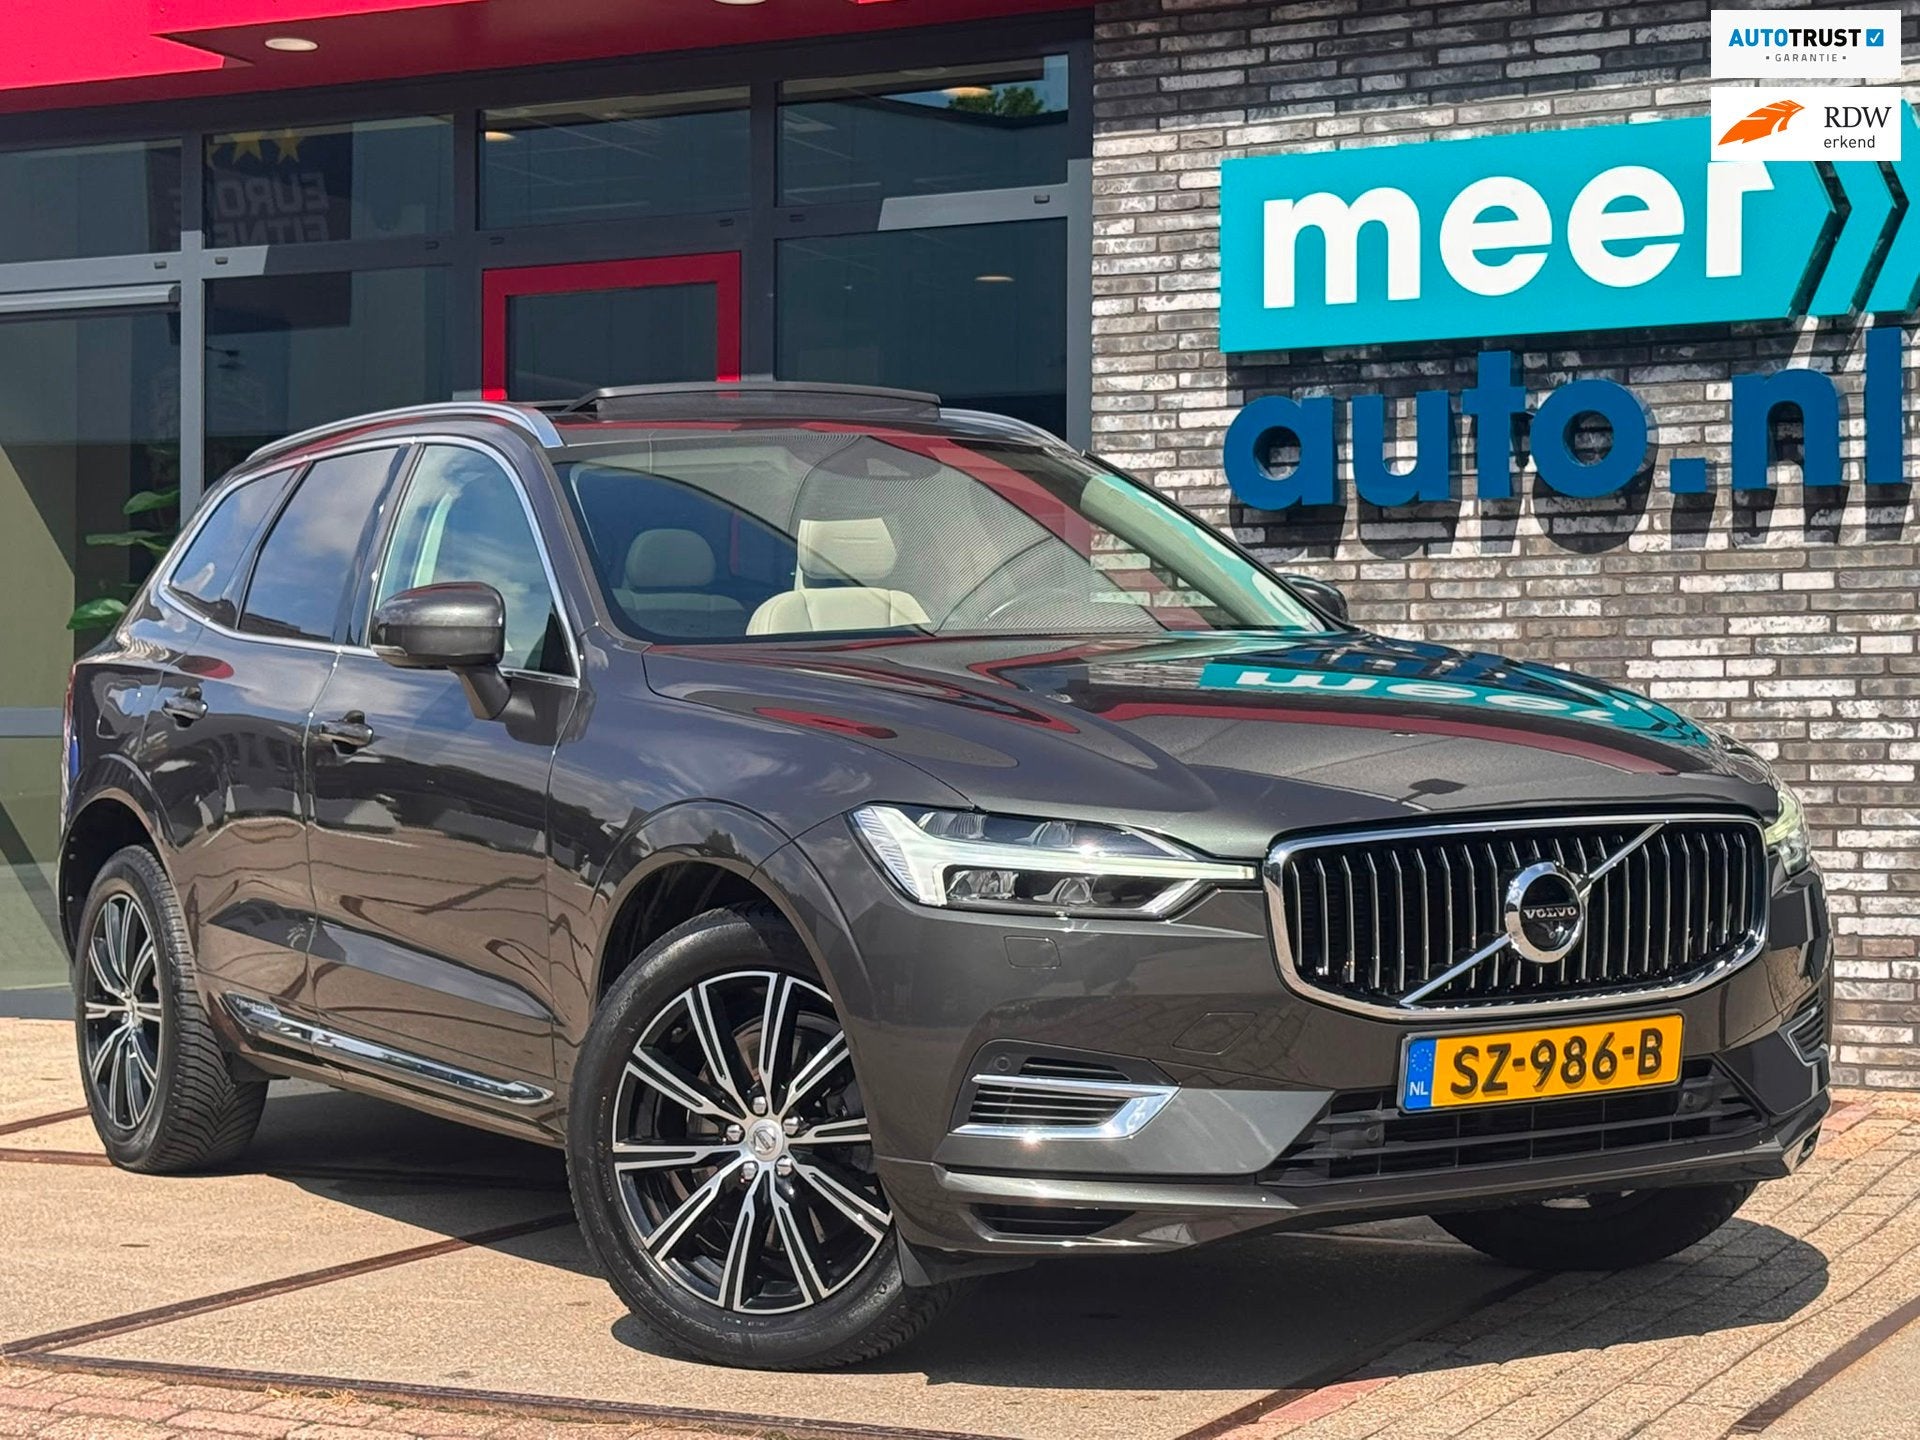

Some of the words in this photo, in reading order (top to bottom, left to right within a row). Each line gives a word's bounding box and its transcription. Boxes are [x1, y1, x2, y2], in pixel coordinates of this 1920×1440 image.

[1263, 162, 1775, 309] meer
[1223, 326, 1903, 511] auto.nl
[1523, 906, 1577, 919] VOLVO
[1409, 1081, 1428, 1096] NL
[1450, 1027, 1663, 1096] SZ-986-B
